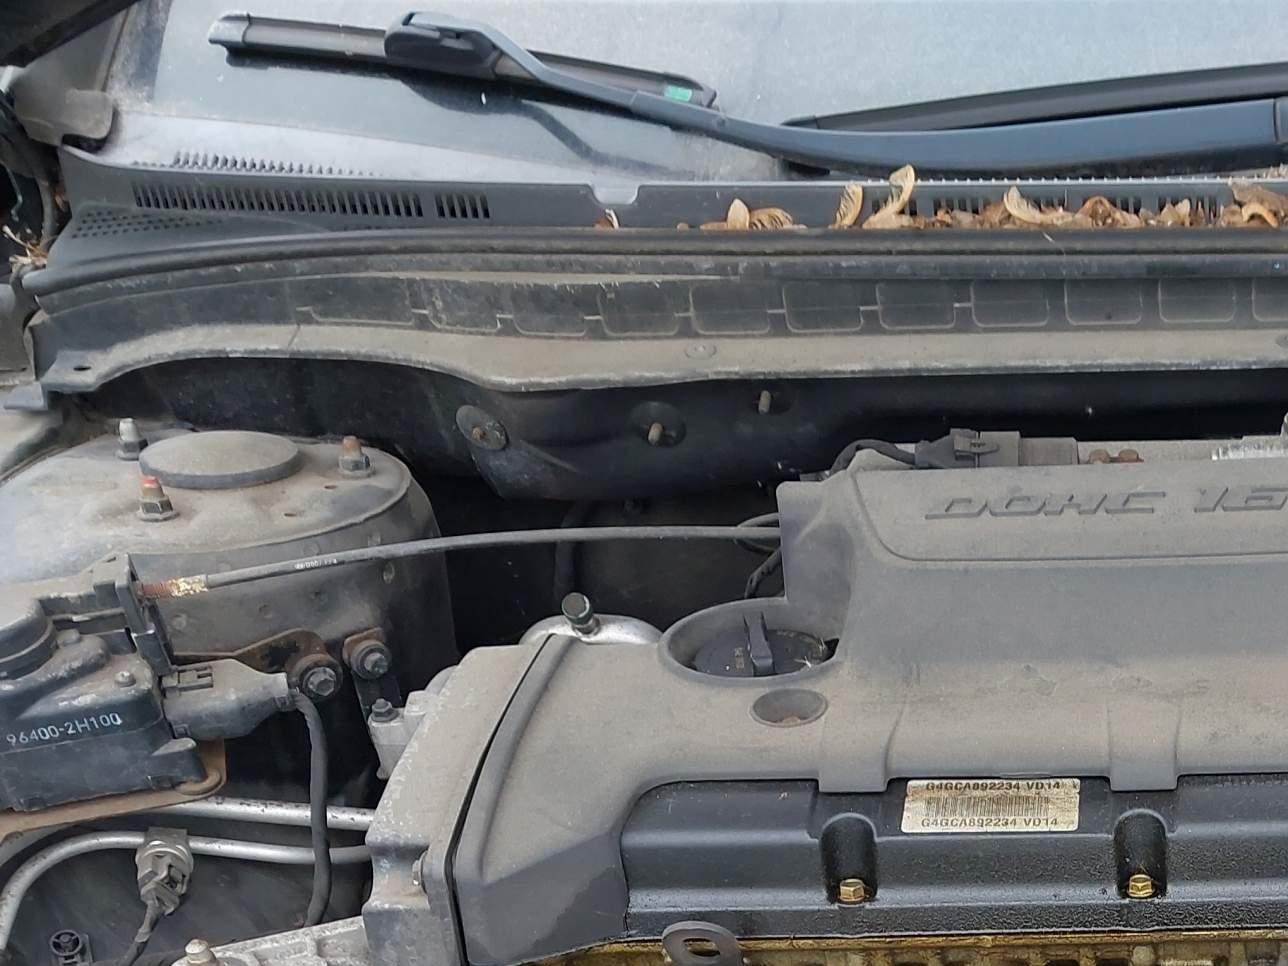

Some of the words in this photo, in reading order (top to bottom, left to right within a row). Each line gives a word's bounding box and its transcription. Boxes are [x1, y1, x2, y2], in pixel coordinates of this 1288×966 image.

[924, 489, 1167, 520] DOHC
[5, 711, 122, 747] 96400-2H100
[920, 817, 1018, 828] G4GCA892234
